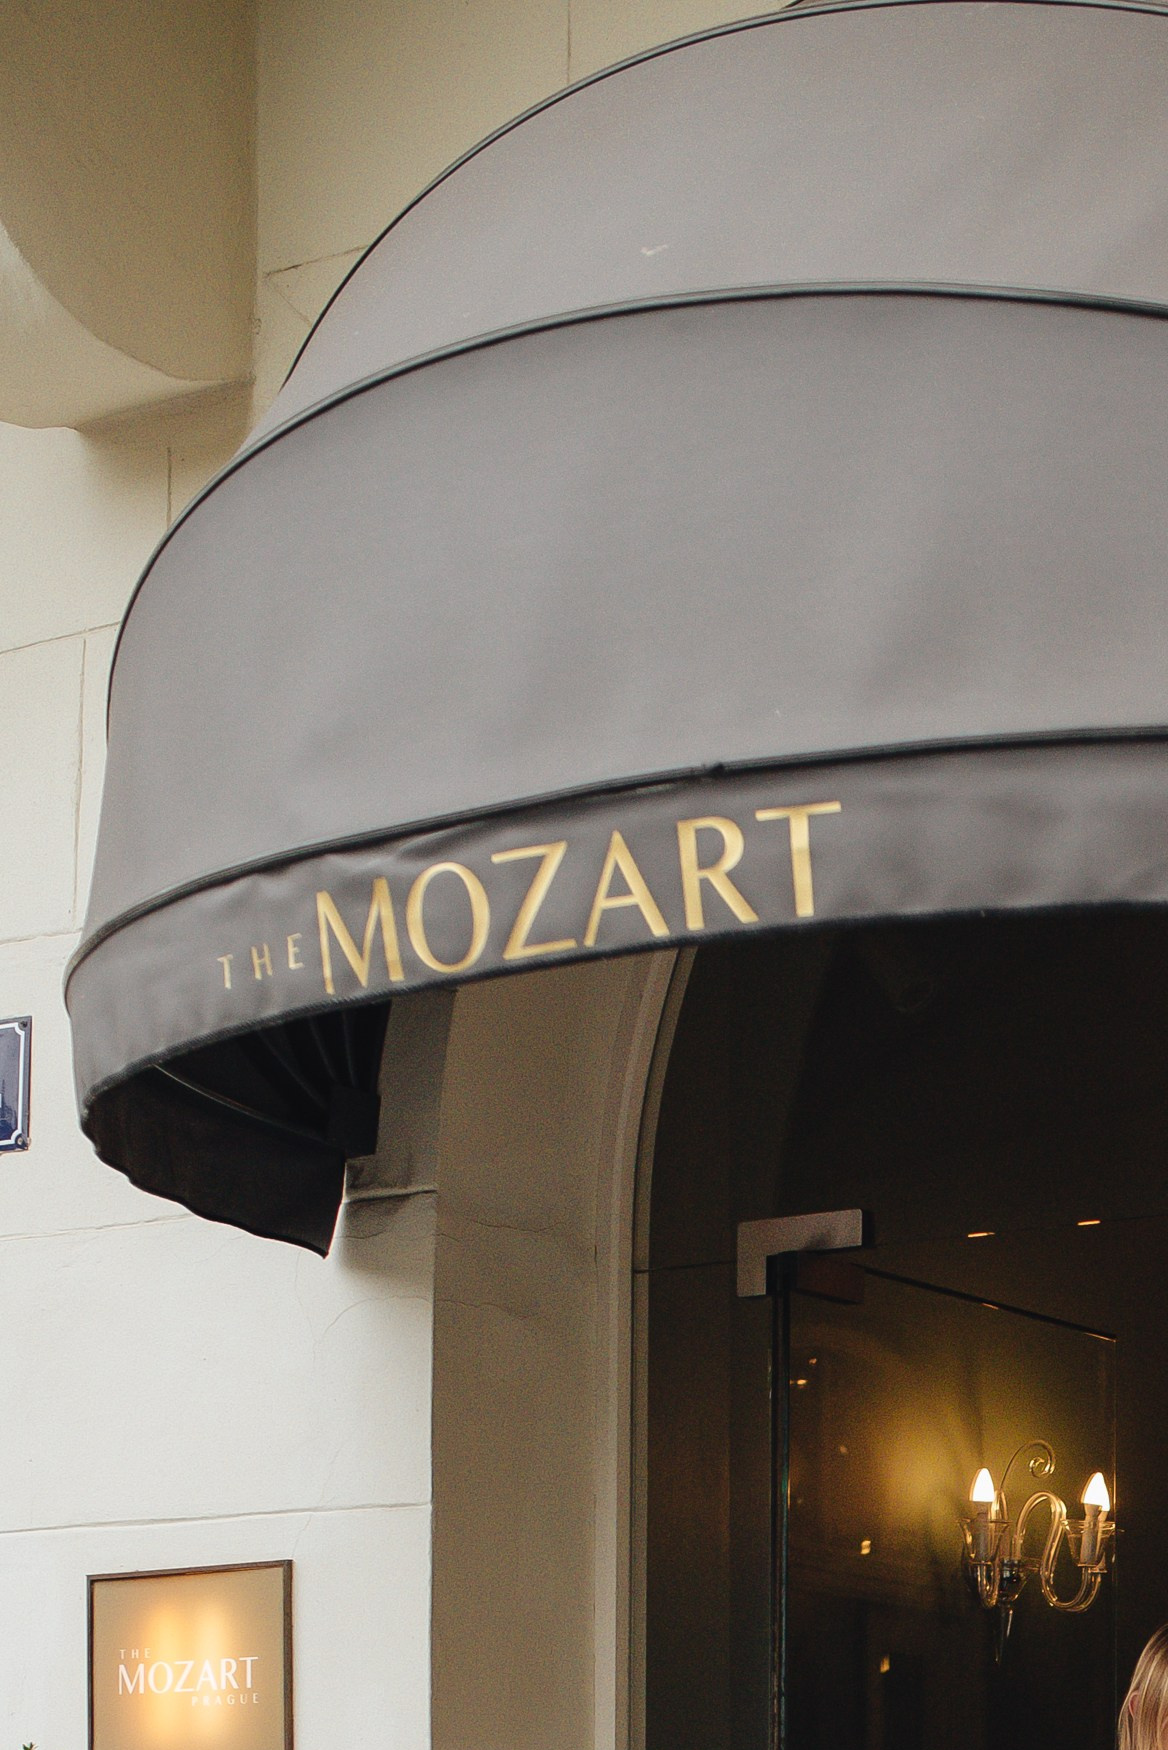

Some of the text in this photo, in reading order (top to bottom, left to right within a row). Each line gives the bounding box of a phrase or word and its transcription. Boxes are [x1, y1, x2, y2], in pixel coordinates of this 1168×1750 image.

[216, 801, 842, 995] THE MOZART
[119, 1648, 151, 1659] THE
[118, 1656, 258, 1695] MOZART
[191, 1693, 259, 1705] PRAGUE
